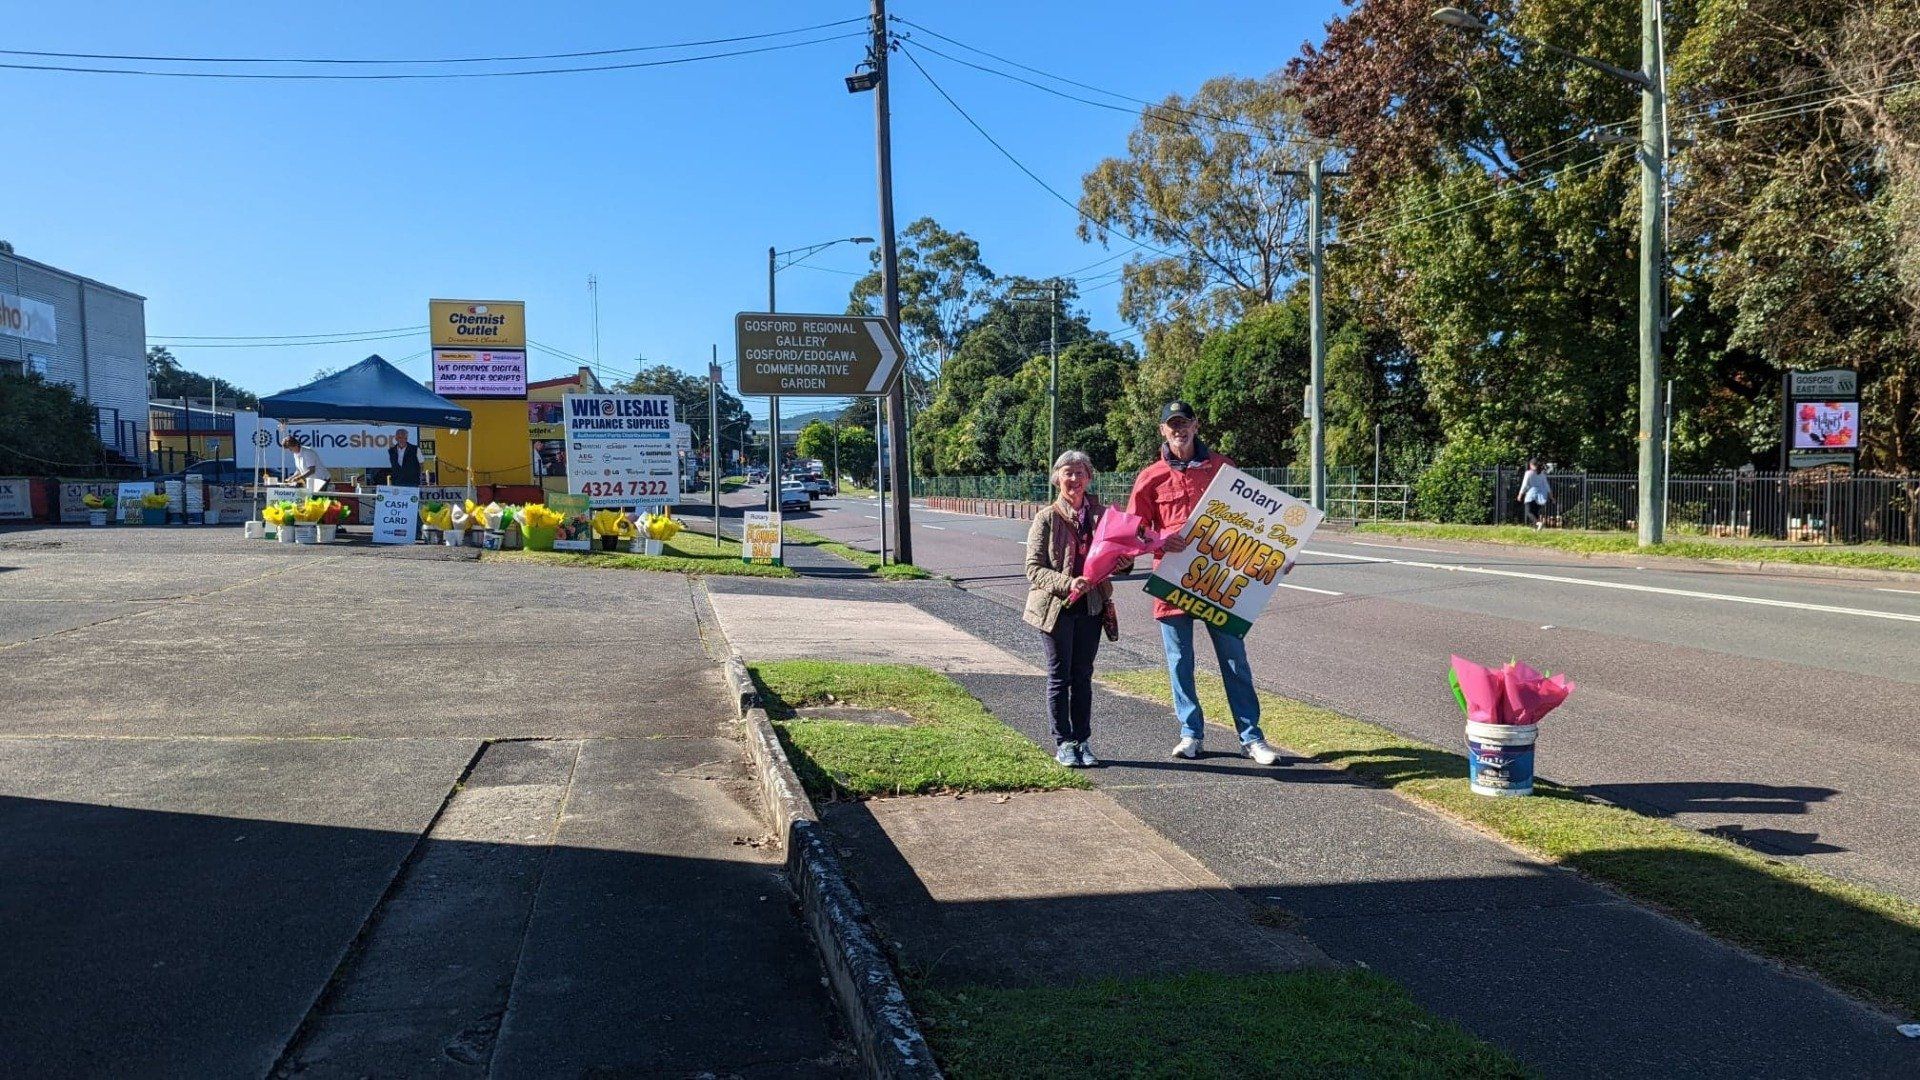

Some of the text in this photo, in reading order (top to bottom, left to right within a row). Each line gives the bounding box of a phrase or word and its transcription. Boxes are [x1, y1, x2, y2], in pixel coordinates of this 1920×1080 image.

[449, 313, 505, 325] Chemist
[457, 325, 498, 336] Outlet
[745, 321, 857, 334] GOSFORD REGIONAL
[776, 336, 828, 348] GALLERY
[746, 350, 857, 362] GOSFORD/EDOGAWA
[453, 365, 489, 373] DISPENSE
[756, 364, 850, 376] COMMEMORATIVE
[460, 374, 487, 382] PAPER
[781, 378, 826, 390] GARDEN
[1797, 376, 1834, 384] GOSFORD
[1797, 385, 1815, 393] EAST
[571, 399, 669, 417] WHOLESALE
[572, 418, 670, 430] APPLIANCE SUPPLIES
[582, 480, 669, 497] 4324 7322
[1230, 478, 1283, 515] Rotary
[384, 500, 408, 509] CASH
[382, 516, 408, 525] CARD
[1206, 499, 1298, 552] Mother's Day
[1184, 514, 1286, 586] FLOWER
[1181, 556, 1250, 609] SALE
[1165, 588, 1229, 627] AHEAD
